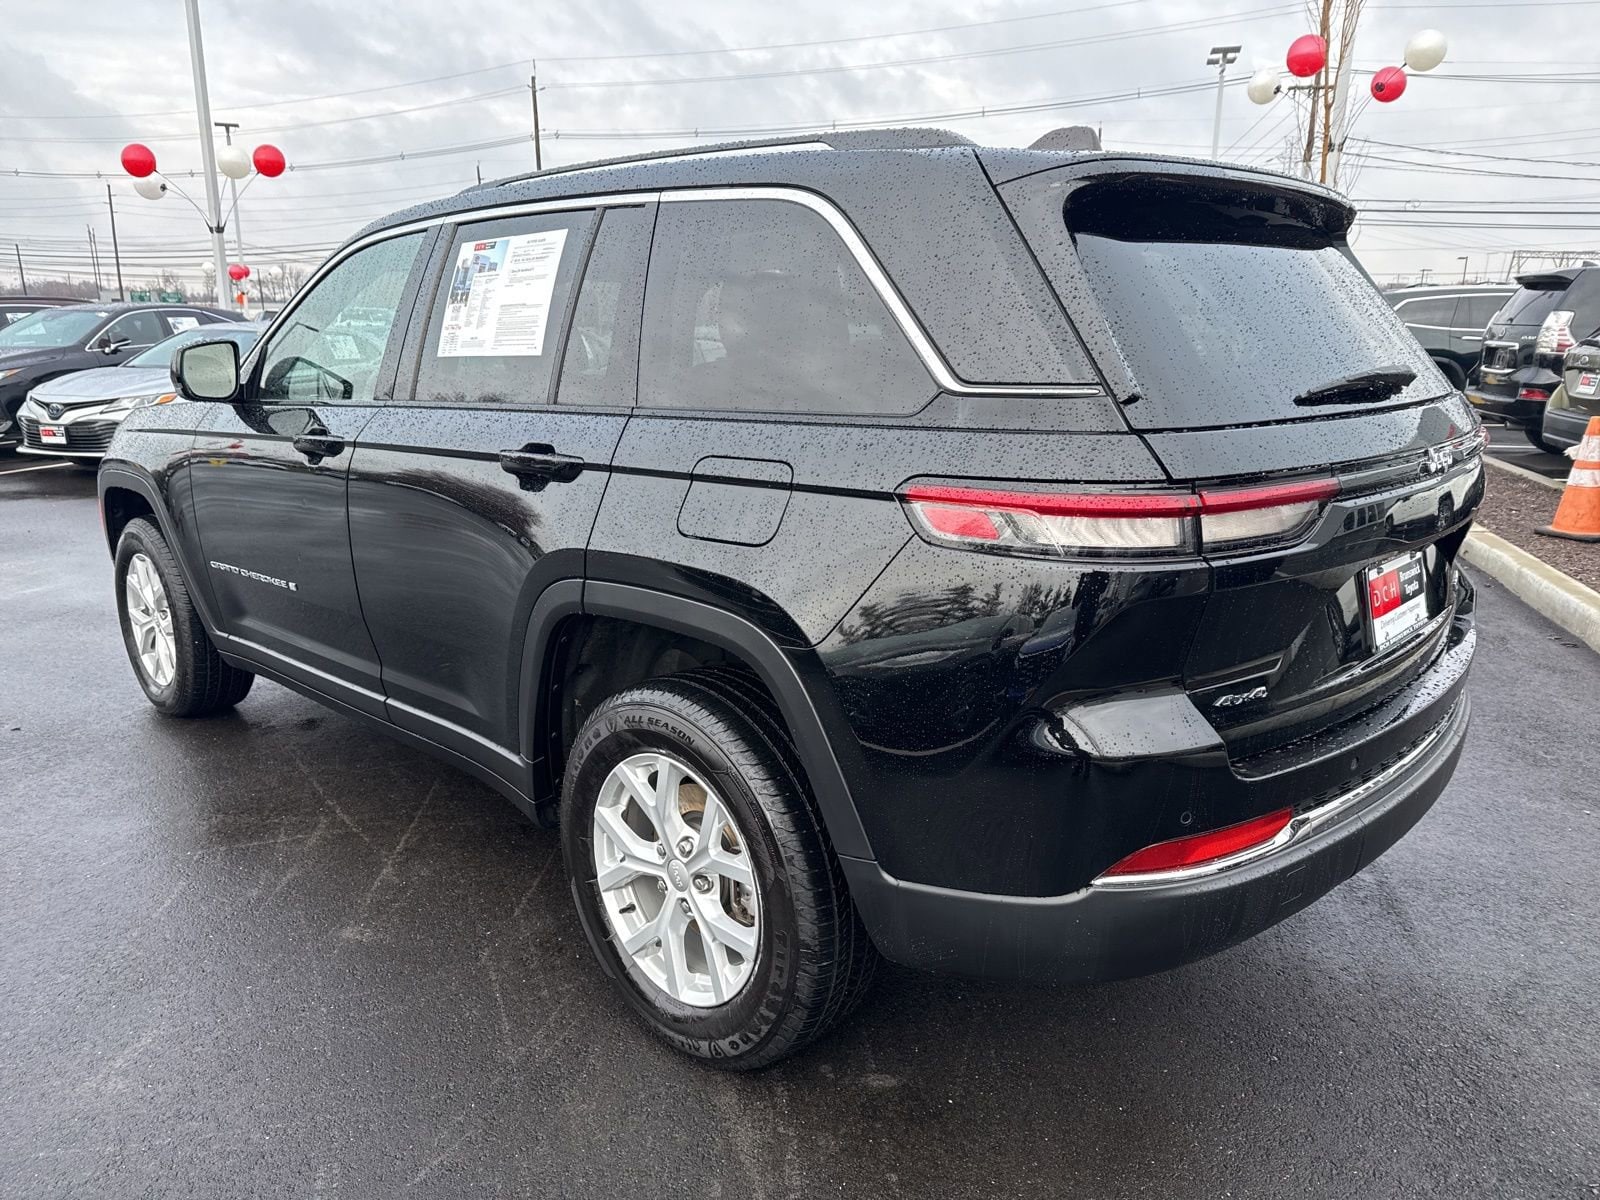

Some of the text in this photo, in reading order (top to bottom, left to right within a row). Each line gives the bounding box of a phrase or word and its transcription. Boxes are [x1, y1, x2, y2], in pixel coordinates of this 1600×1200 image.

[1373, 580, 1398, 607] DCH
[623, 714, 695, 746] ALL SEASON
